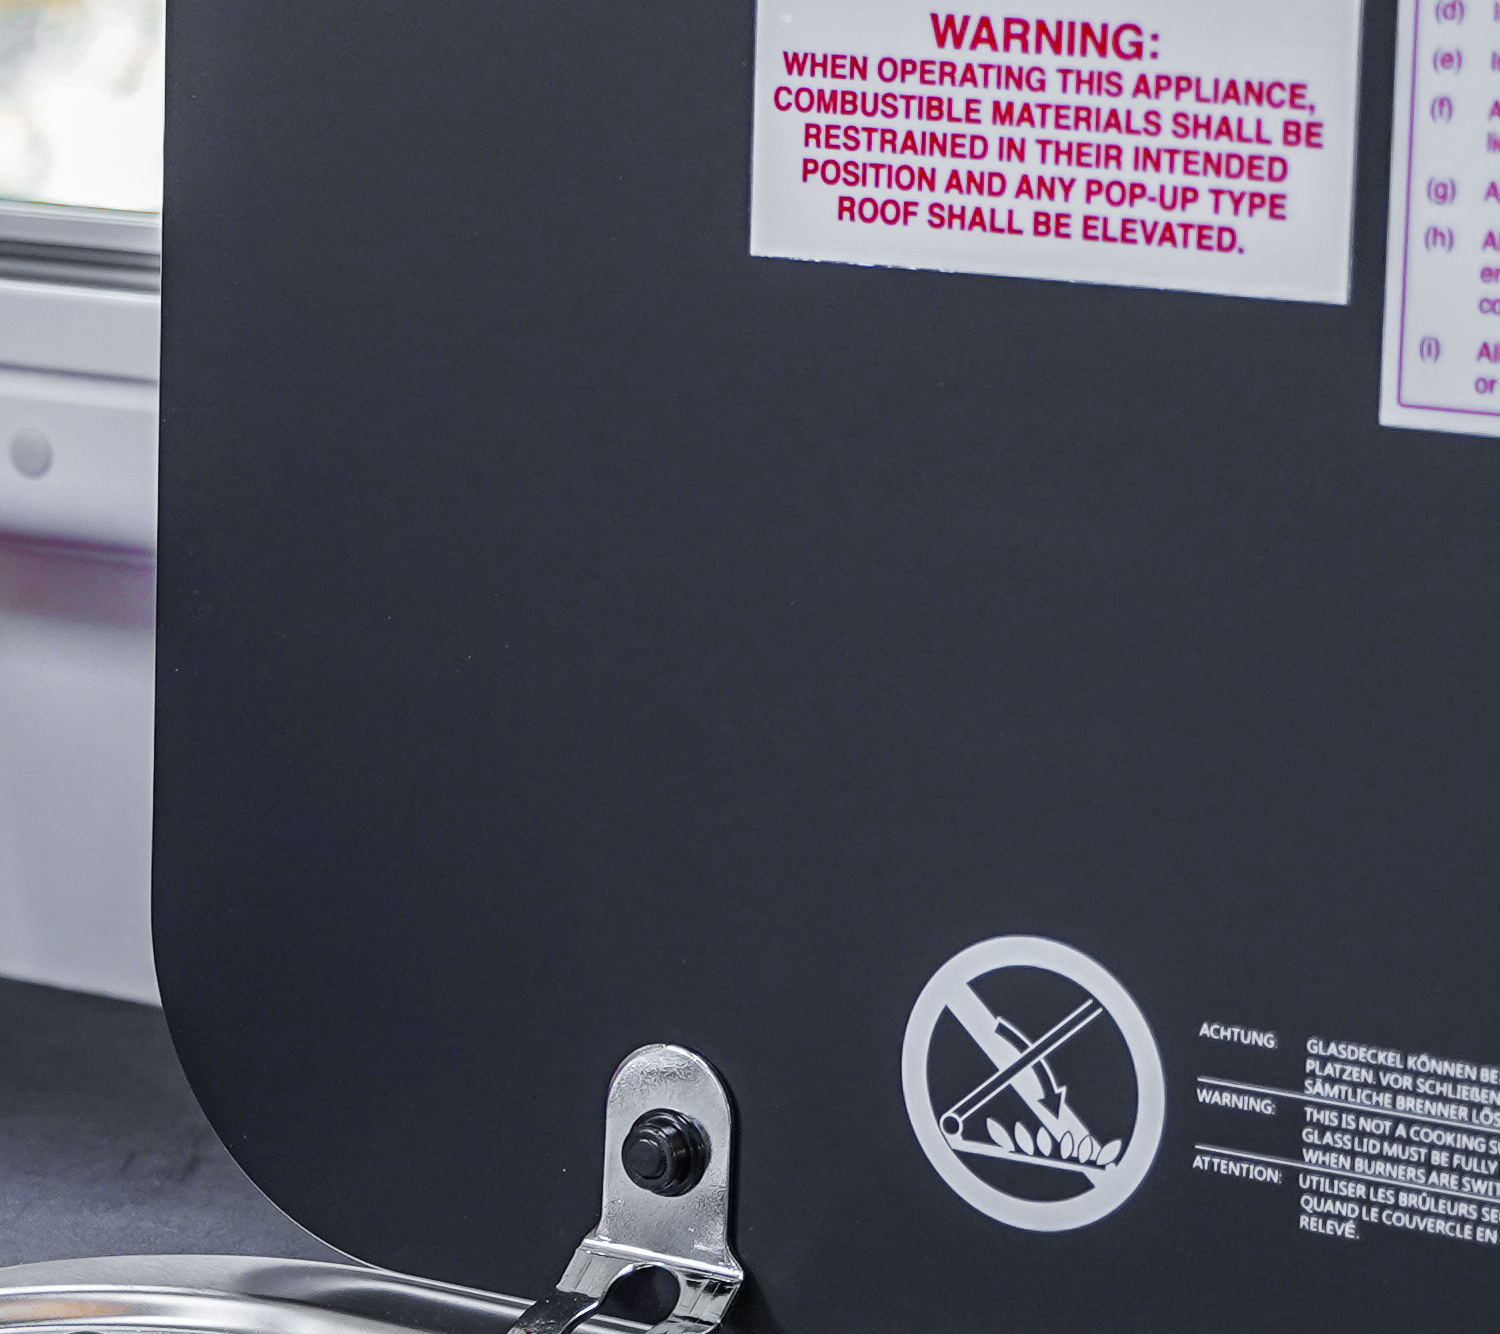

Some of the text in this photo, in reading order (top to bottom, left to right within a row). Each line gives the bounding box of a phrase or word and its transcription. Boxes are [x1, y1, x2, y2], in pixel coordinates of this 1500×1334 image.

[930, 12, 1159, 61] WARNING:
[782, 50, 1316, 115] WHEN OPERATING THIS APPLIANCE,
[774, 85, 1324, 149] COMBUSTIBLE MATERIALS SHALL BE
[804, 122, 1288, 183] RESTRAINED IN THEIR INTENDED
[802, 158, 1287, 221] POSITION AND ANY POP-UP TYPE
[838, 195, 1244, 254] ROOF SHALL BE ELEVATED.
[1306, 1058, 1376, 1085] PLATZEN.
[1379, 1071, 1413, 1091] VOR
[1307, 1038, 1404, 1069] GLASDECKEL
[1196, 1088, 1276, 1115] WARNING:
[1395, 1095, 1469, 1121] BRENNER
[1302, 1127, 1352, 1150] GLASS
[1354, 1136, 1381, 1155] LID
[1383, 1141, 1428, 1163] MUST
[1431, 1149, 1450, 1167] BE
[1453, 1153, 1498, 1175] FULLY
[1304, 1106, 1339, 1127] THIS
[1341, 1113, 1357, 1130] IS
[1358, 1116, 1393, 1135] NOT
[1395, 1123, 1407, 1139] A
[1409, 1125, 1486, 1153] COOKING
[1193, 1154, 1282, 1184] ATTENTION:
[1303, 1148, 1351, 1171] WHEN
[1355, 1157, 1426, 1184] BURNERS
[1427, 1171, 1459, 1191] ARE
[1299, 1173, 1366, 1199] UTILISER
[1369, 1186, 1395, 1205] LES
[1398, 1191, 1478, 1220] BRÛLEURS
[1300, 1194, 1360, 1219] QUAND
[1362, 1205, 1379, 1223] LE
[1381, 1209, 1473, 1240] COUVERCLE
[1476, 1226, 1498, 1244] EN
[1299, 1214, 1359, 1239] RELEVÉ.
